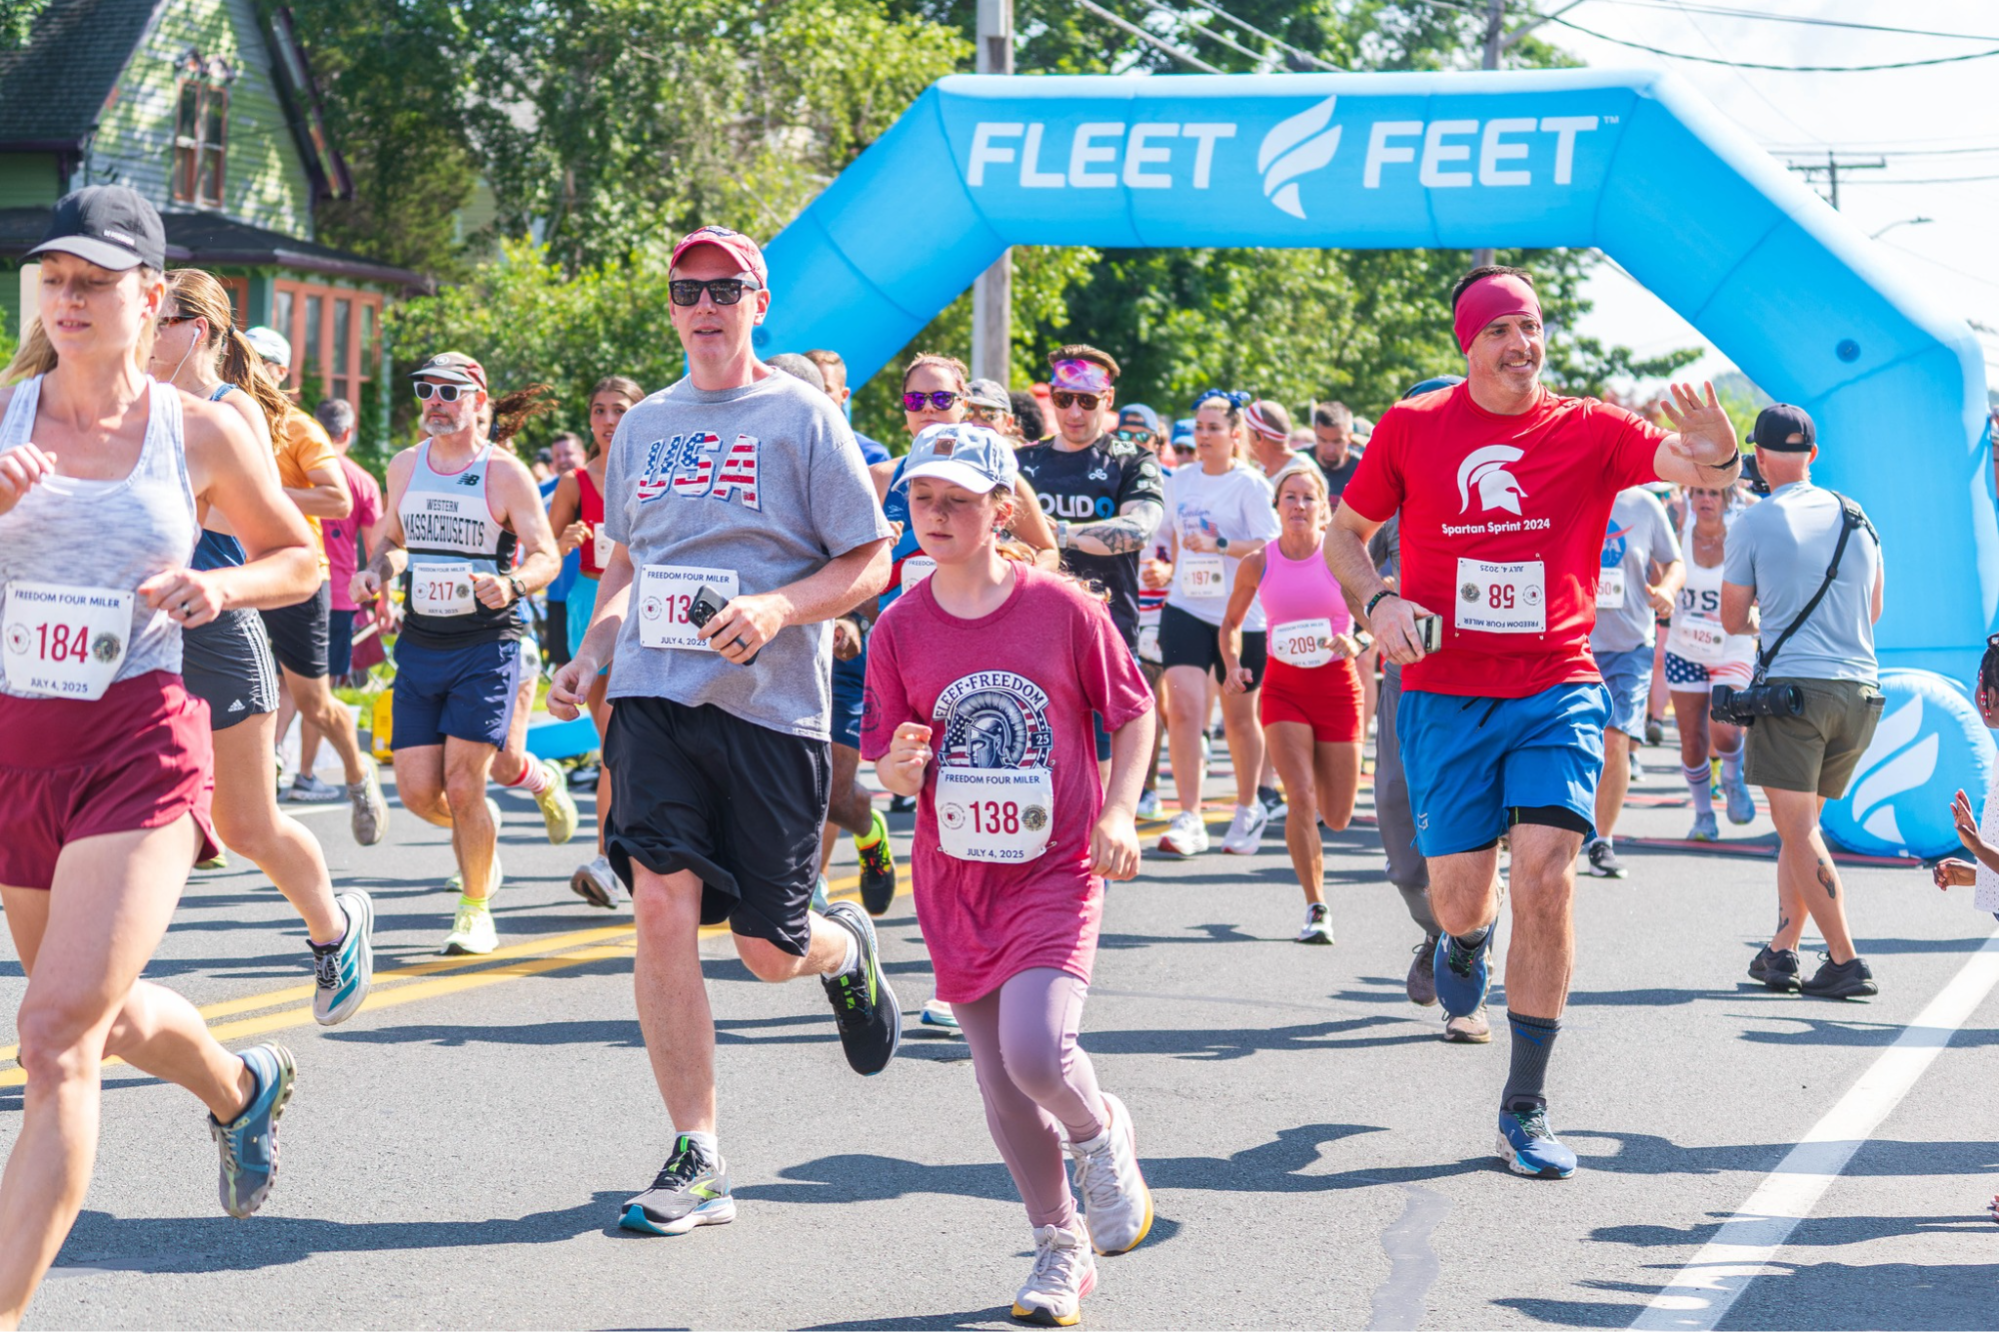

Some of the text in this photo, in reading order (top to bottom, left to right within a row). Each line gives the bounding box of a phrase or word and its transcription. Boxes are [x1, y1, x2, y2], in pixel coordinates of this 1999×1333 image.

[967, 122, 1237, 189] FLEET
[1363, 115, 1599, 188] FEET
[637, 431, 762, 513] USA
[426, 498, 459, 512] WESTERN
[1037, 493, 1115, 519] OUD9
[404, 514, 484, 546] MASSACHUSETTS
[1442, 518, 1550, 536] Spartan Sprint 2024
[648, 571, 681, 579] FREEDOM
[706, 575, 729, 583] MILER
[1192, 571, 1209, 585] 197
[429, 582, 453, 600] 217
[1489, 584, 1514, 609] 58
[1598, 582, 1611, 596] 50
[15, 590, 119, 608] FREEDOM FOUR MILER
[1680, 588, 1719, 611] US
[666, 594, 697, 624] 13
[1464, 618, 1484, 626] MILER
[1486, 620, 1505, 628] FOUR
[36, 623, 88, 664] 184
[687, 638, 706, 646] 2025
[1289, 636, 1316, 654] 209
[1693, 630, 1711, 644] 125
[31, 678, 88, 693] JULY 4, 2025
[969, 673, 1044, 705] FREEDOM
[1036, 734, 1049, 745] 25
[945, 774, 1040, 784] FREEDOM FOUR MILER
[969, 801, 1019, 834] 138
[967, 848, 1024, 858] JULY 4, 2025
